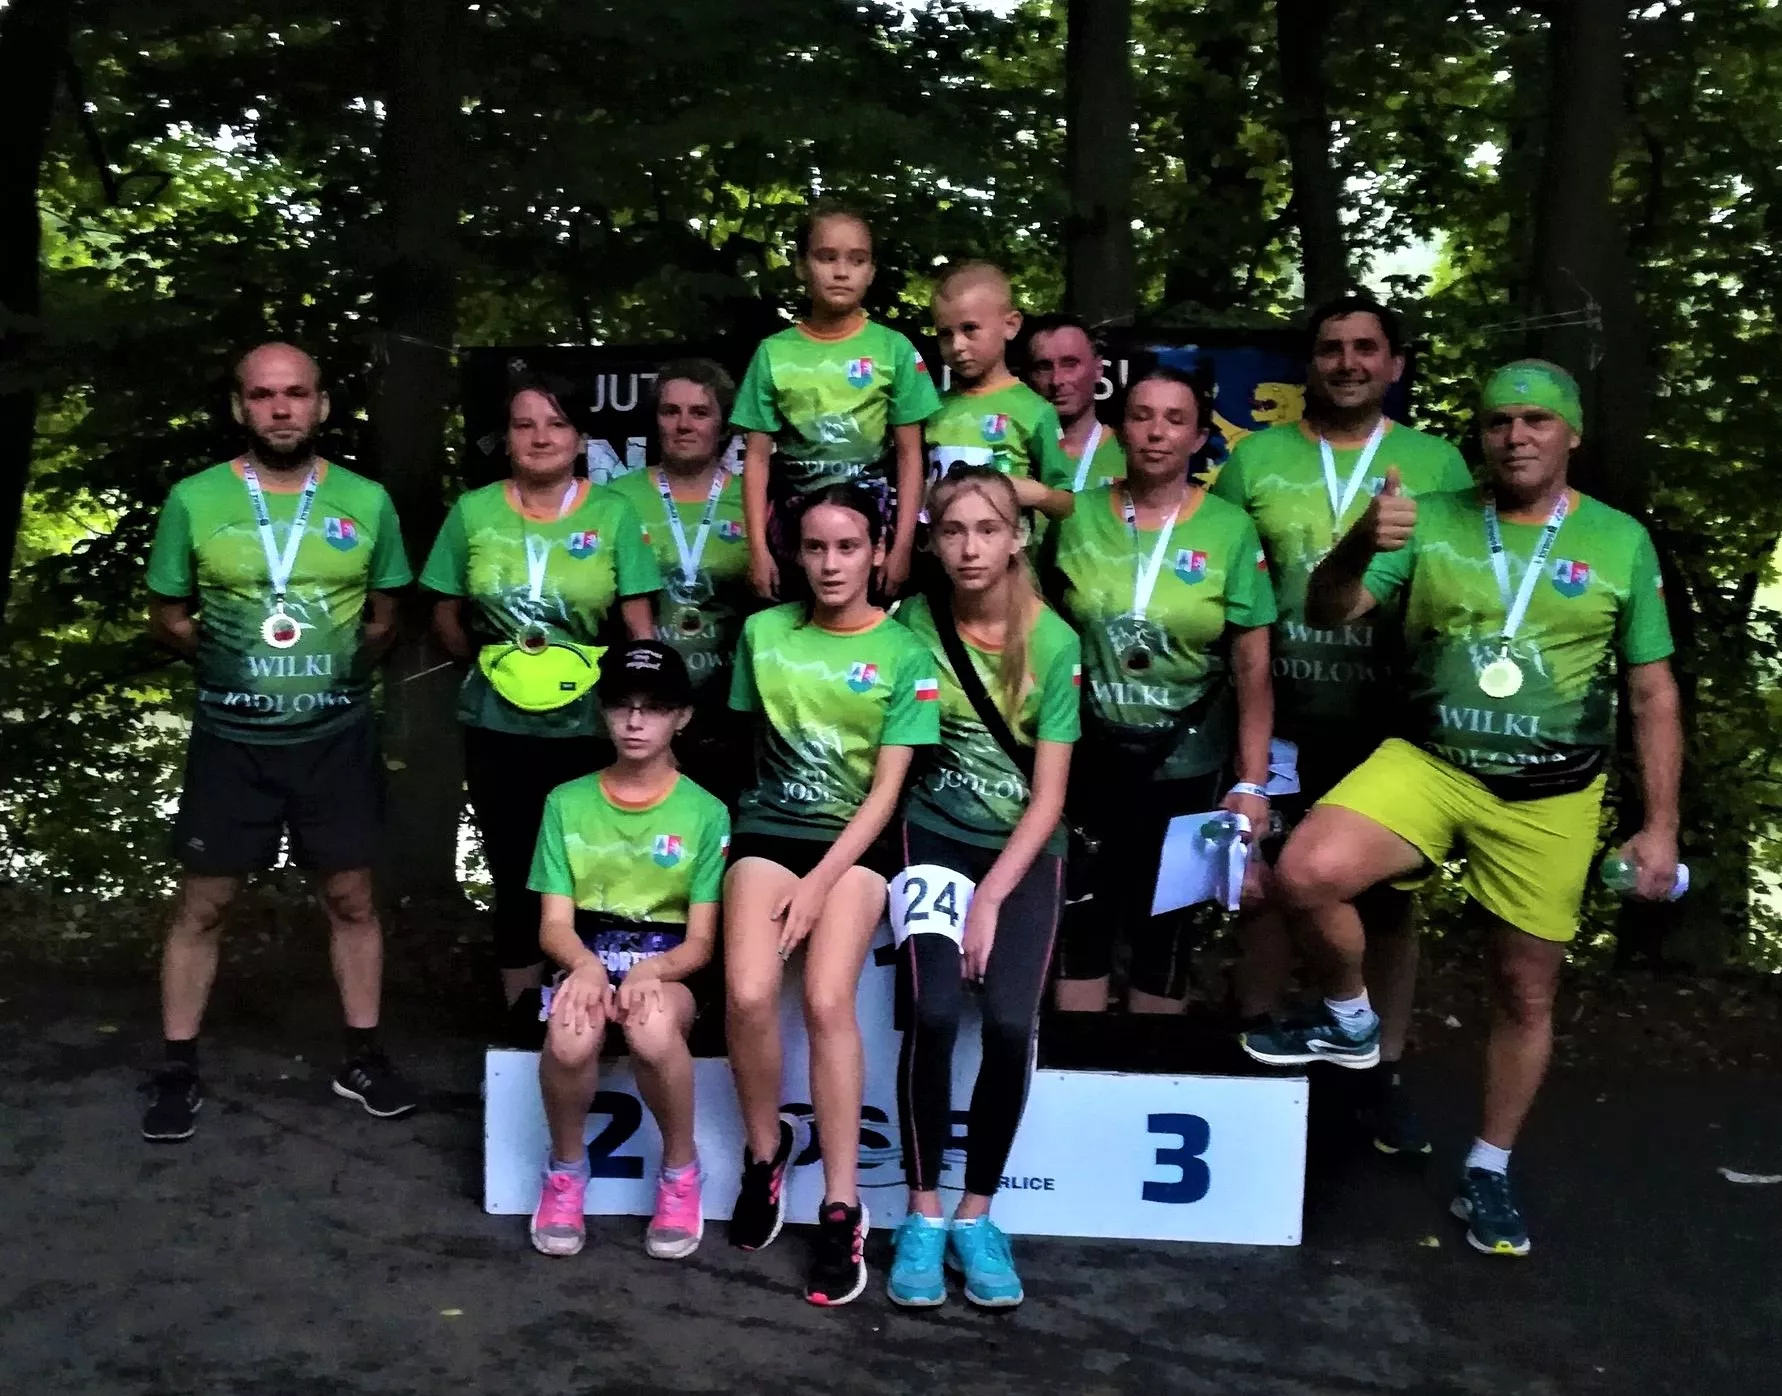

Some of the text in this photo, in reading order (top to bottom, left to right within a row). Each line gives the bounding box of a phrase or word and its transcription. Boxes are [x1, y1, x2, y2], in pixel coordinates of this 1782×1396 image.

[247, 654, 332, 677] WILKI
[1090, 680, 1170, 706] WILKI
[1438, 704, 1541, 738] WILKI
[903, 876, 959, 928] 24
[586, 1090, 645, 1179] 2
[1141, 1112, 1211, 1205] 3
